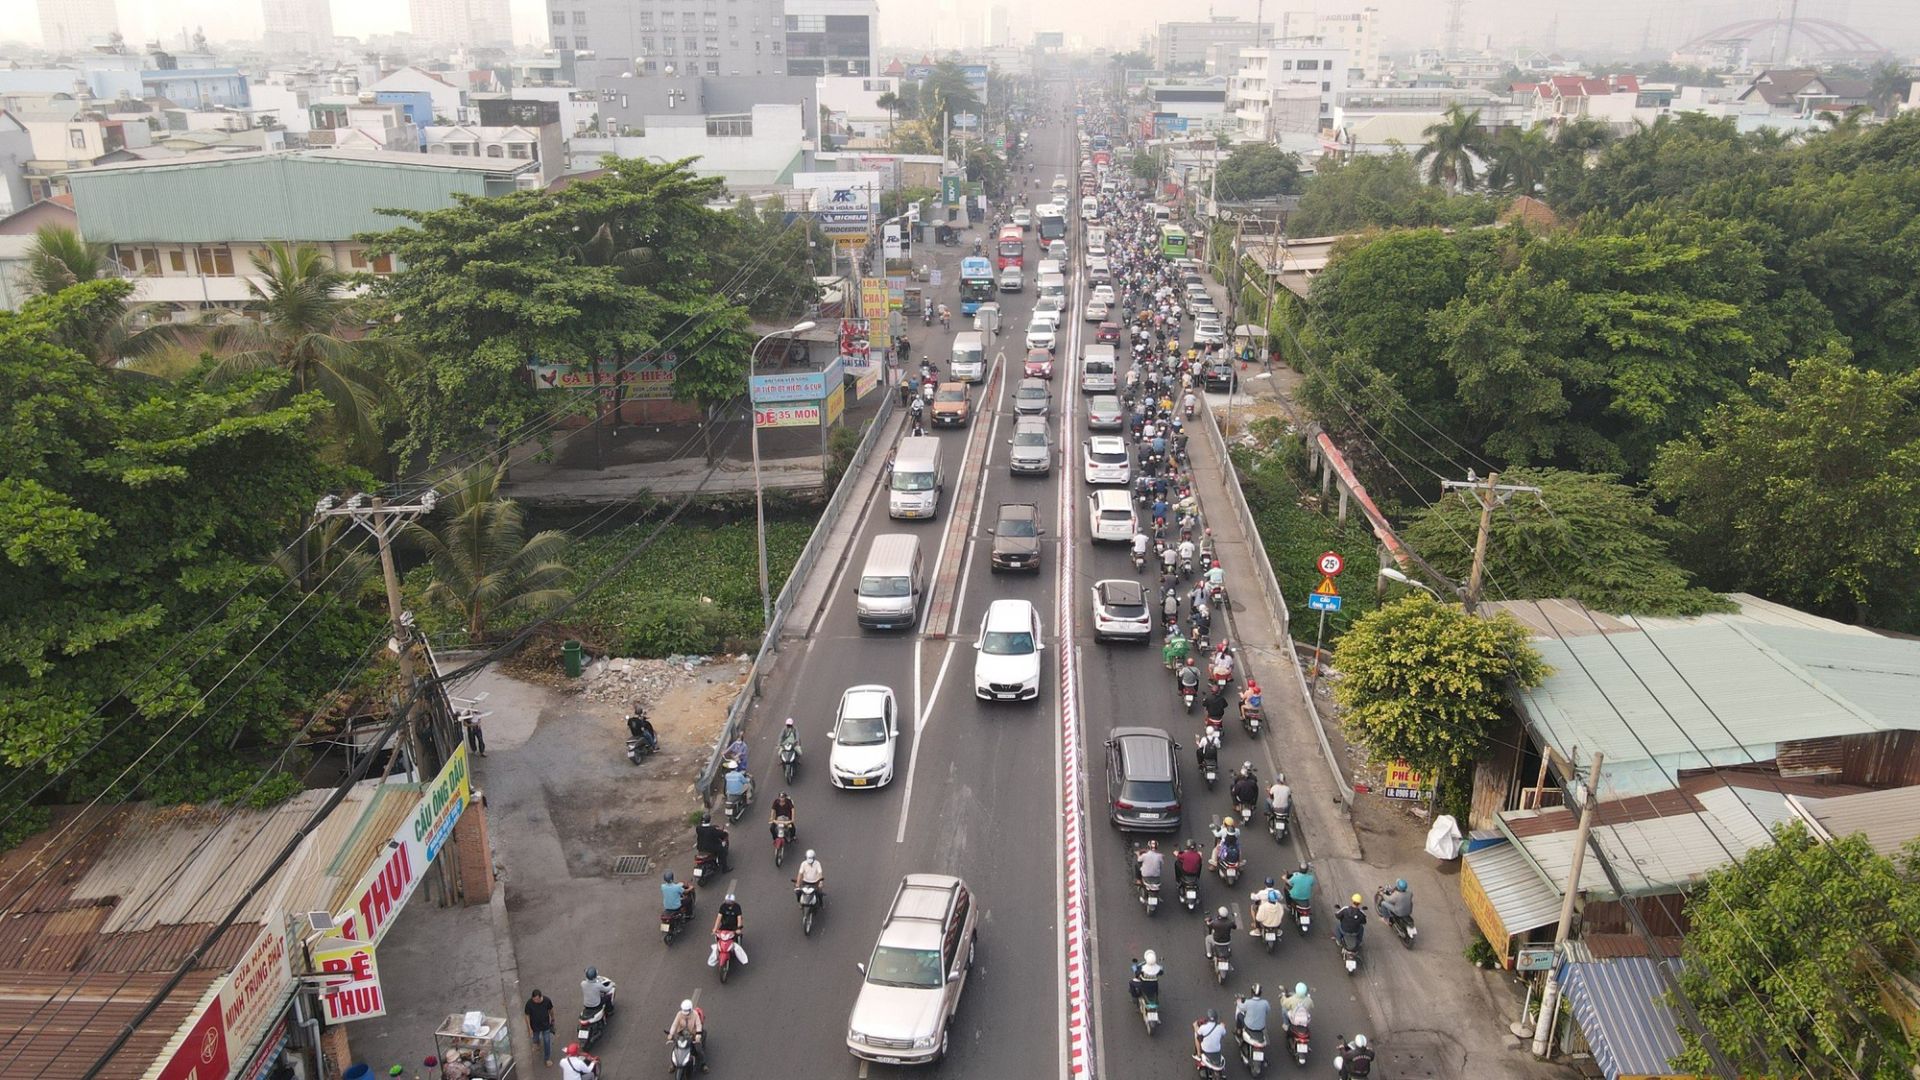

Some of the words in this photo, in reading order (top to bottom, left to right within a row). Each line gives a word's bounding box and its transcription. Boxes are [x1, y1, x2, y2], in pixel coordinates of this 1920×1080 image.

[824, 225, 867, 233] BRIDGESTONE
[755, 409, 777, 425] DÊ
[779, 411, 791, 419] 35
[432, 780, 450, 818] ÔNG
[360, 841, 412, 940] THUI
[322, 951, 374, 986] BÊ
[226, 992, 246, 1032] MINH
[245, 961, 268, 1003] TRUNG
[325, 986, 381, 1018] THUI
